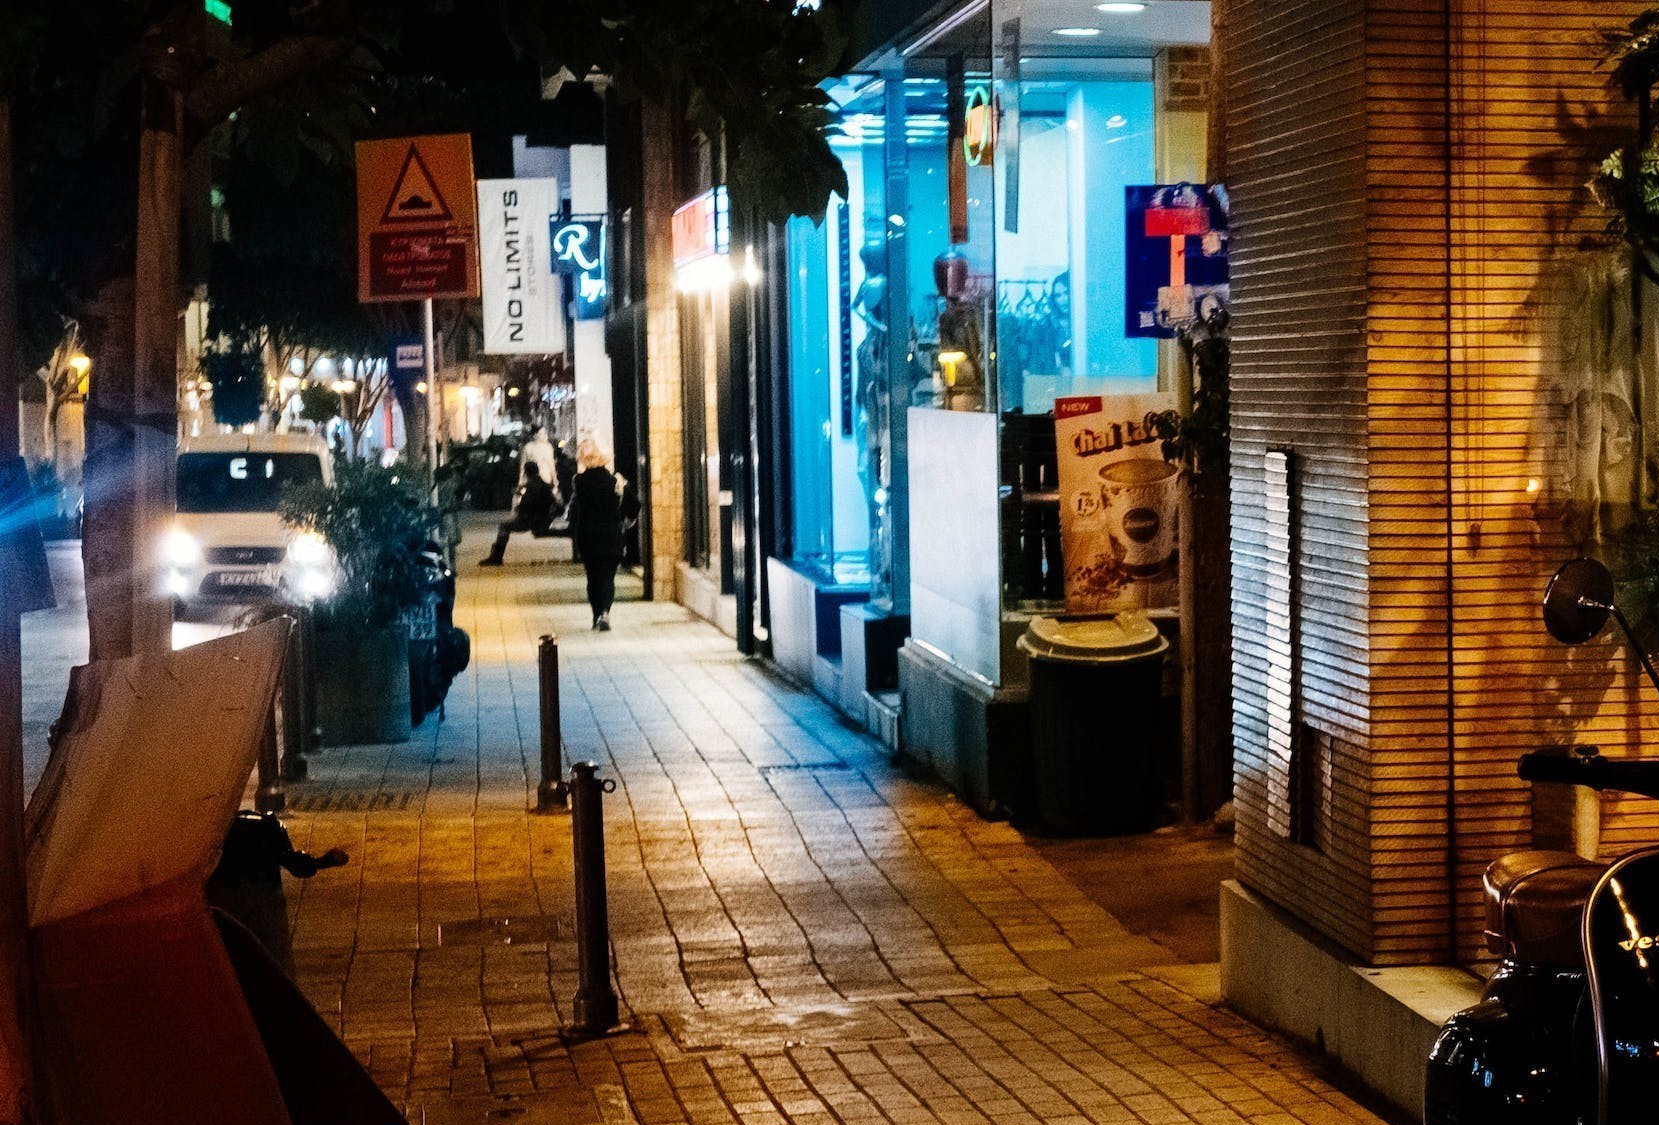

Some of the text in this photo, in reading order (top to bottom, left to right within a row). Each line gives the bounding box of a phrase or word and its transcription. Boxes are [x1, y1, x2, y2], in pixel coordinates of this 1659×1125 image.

[503, 189, 523, 342] NO LIMITS
[1061, 401, 1089, 412] NEW
